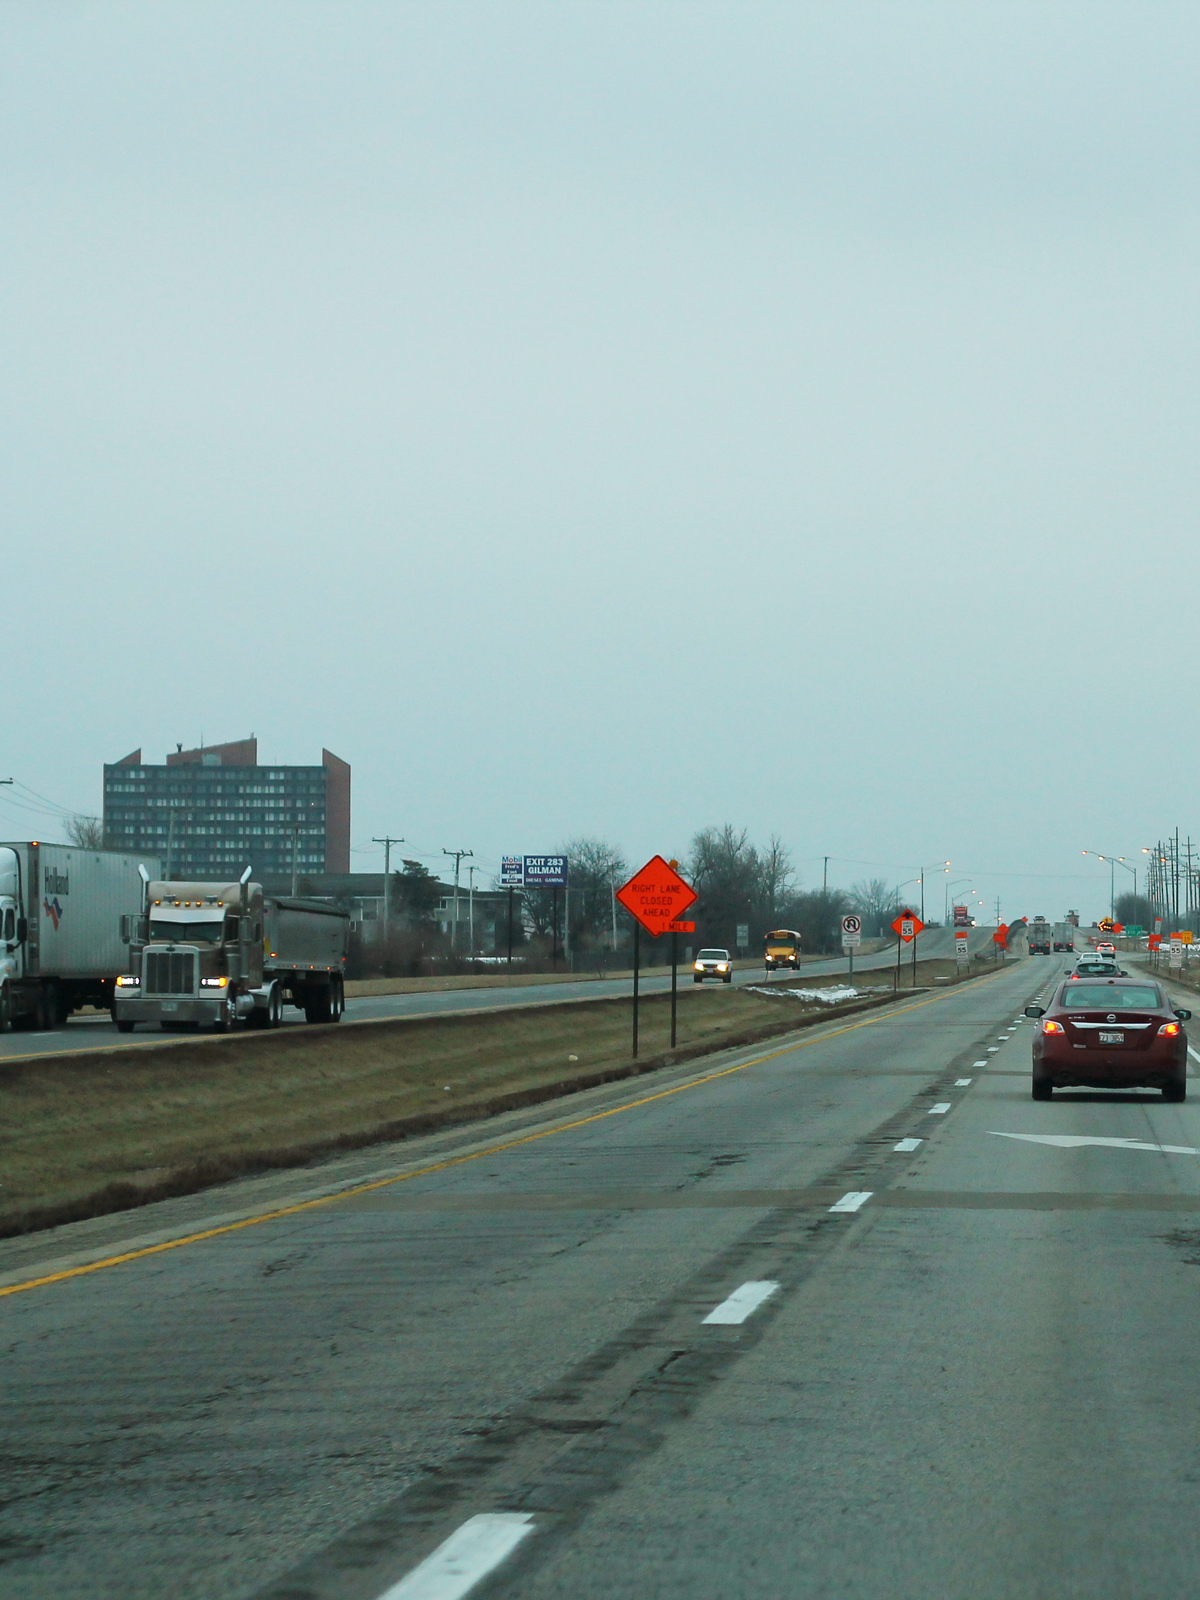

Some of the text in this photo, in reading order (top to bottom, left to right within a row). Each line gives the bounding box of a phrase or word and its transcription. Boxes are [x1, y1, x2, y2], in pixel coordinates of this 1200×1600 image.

[526, 858, 563, 866] EXIT 283
[528, 866, 561, 874] GILMAN
[44, 865, 70, 895] Holland
[631, 884, 681, 893] RIGHT LANE
[640, 896, 673, 905] CLOSED
[643, 908, 670, 917] AHEAD
[669, 922, 688, 931] MILE
